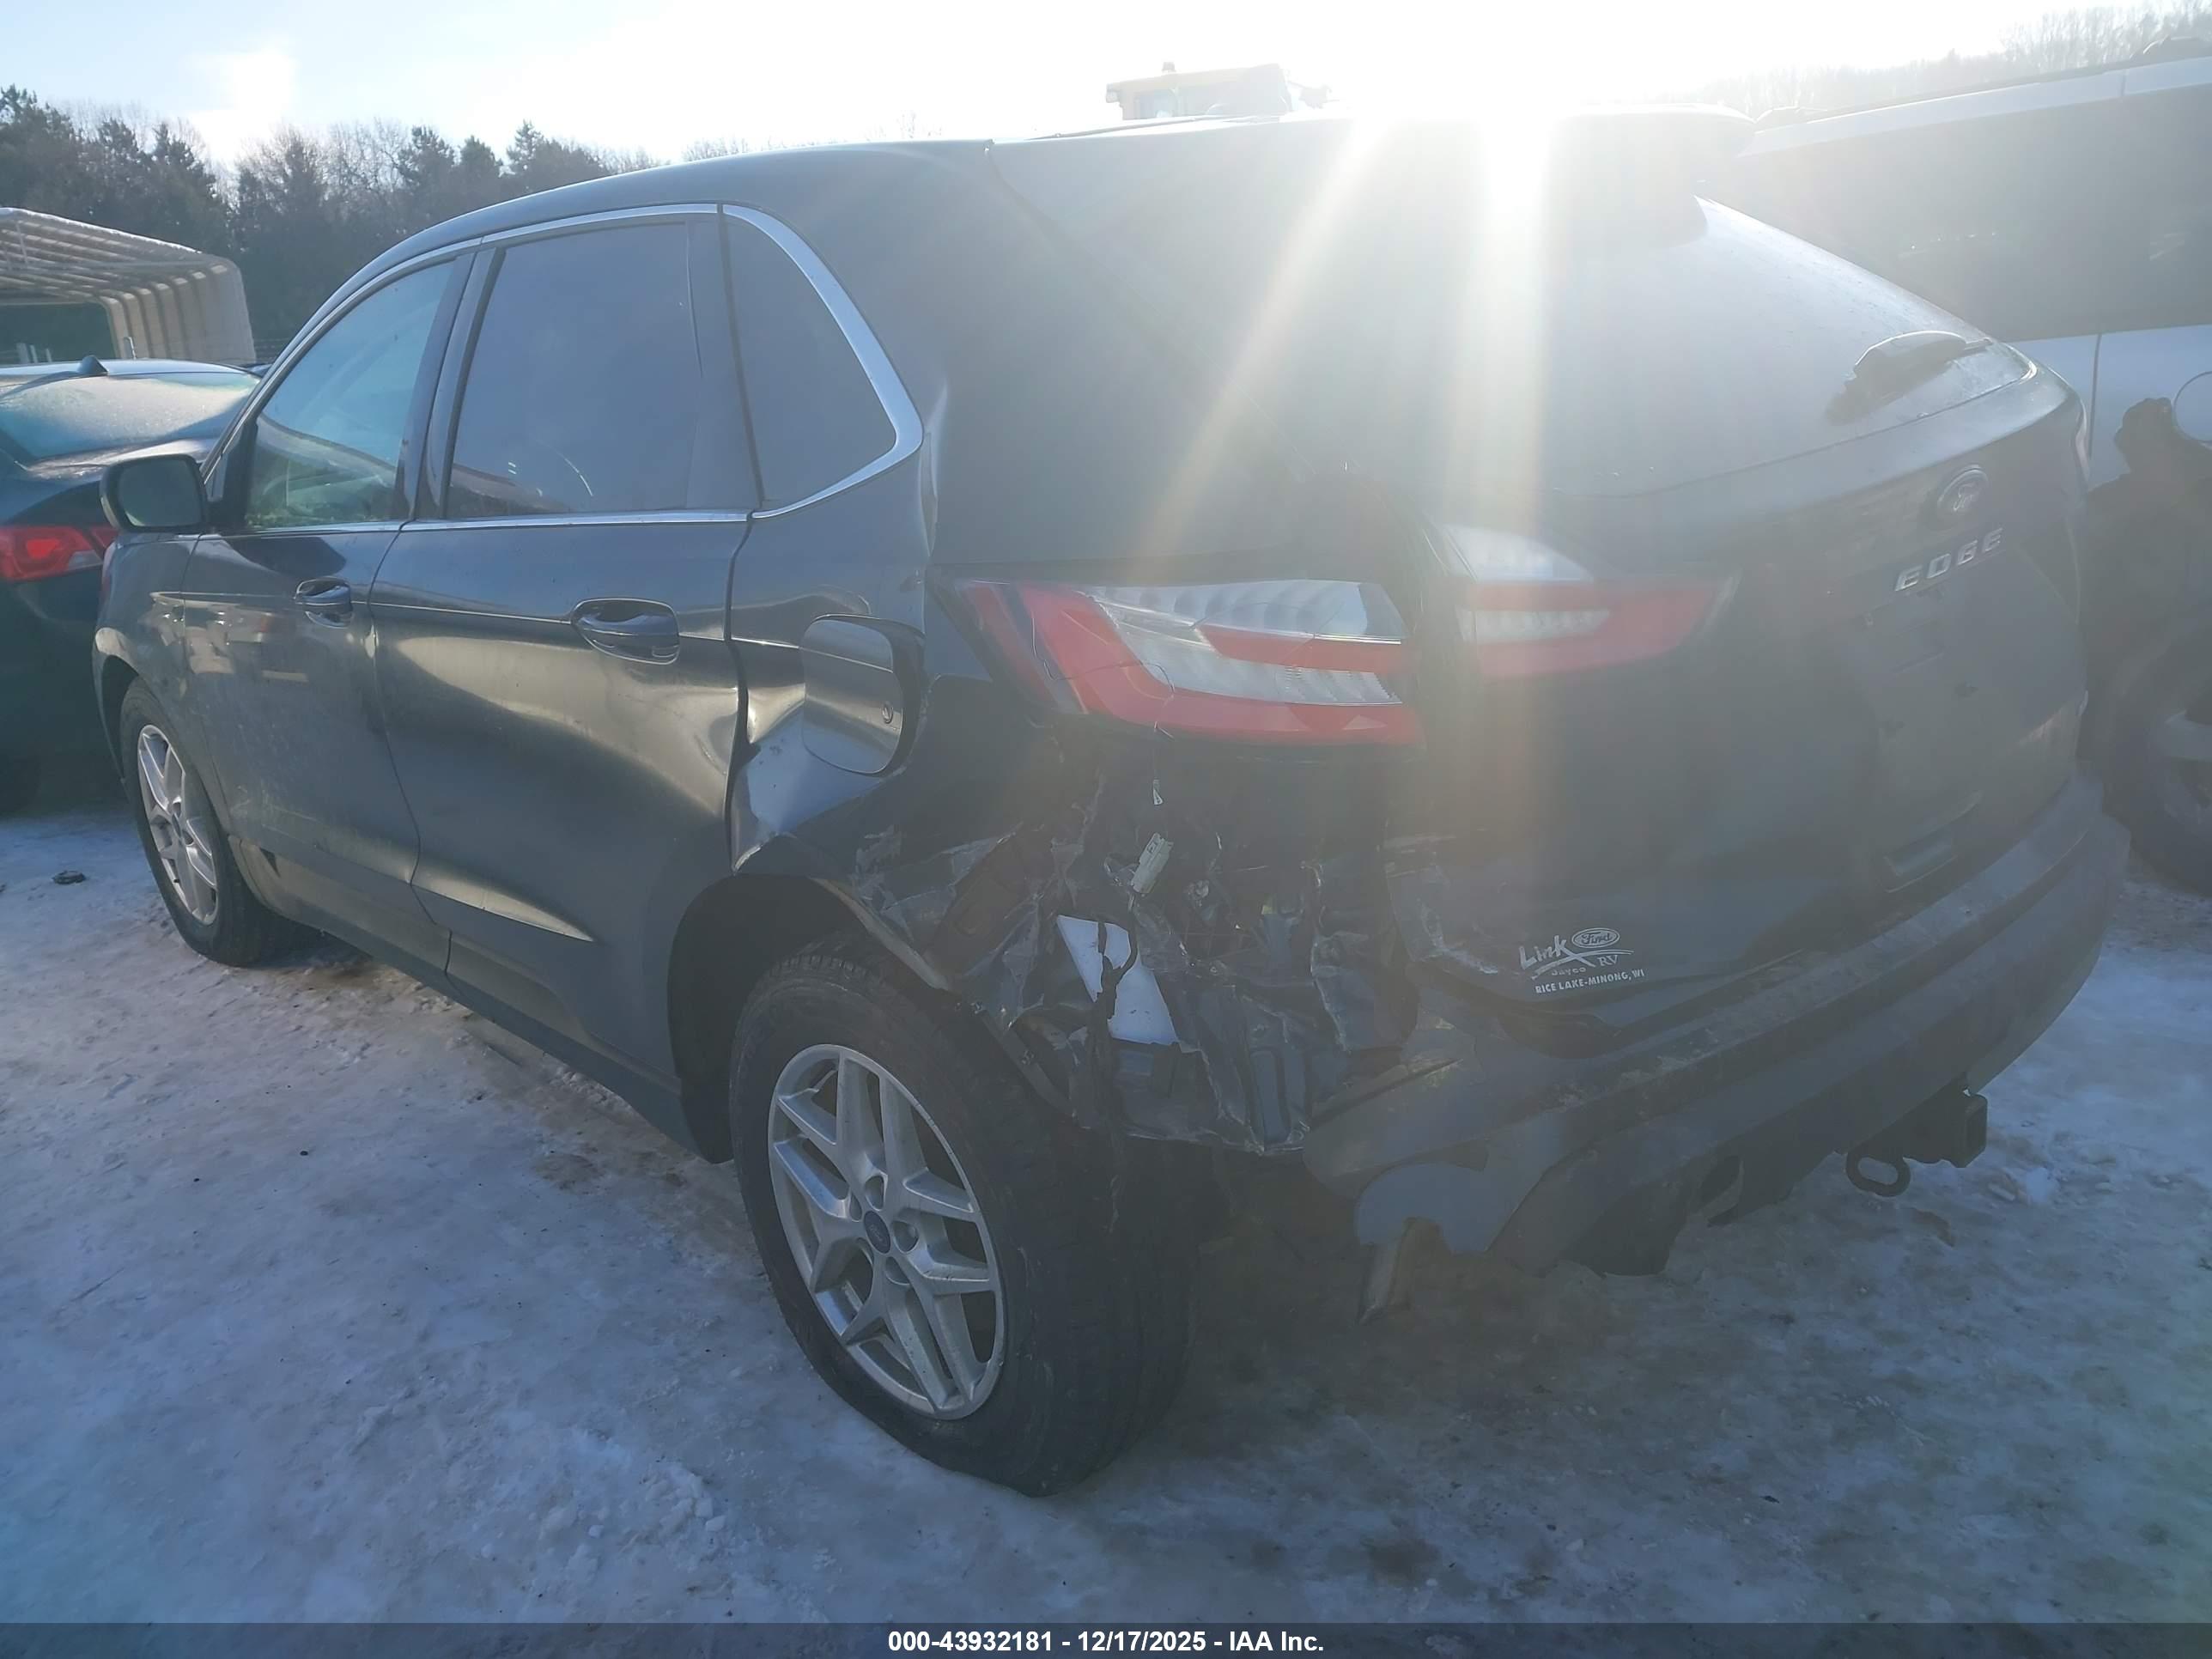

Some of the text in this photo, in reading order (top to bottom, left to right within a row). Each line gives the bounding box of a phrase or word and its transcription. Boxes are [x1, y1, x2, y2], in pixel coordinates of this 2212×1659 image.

[1894, 527, 2003, 591] EDGE
[1519, 935, 1568, 969] Link
[1598, 955, 1619, 967] RV
[1535, 983, 1557, 994] RICE
[1632, 969, 1645, 978] WI
